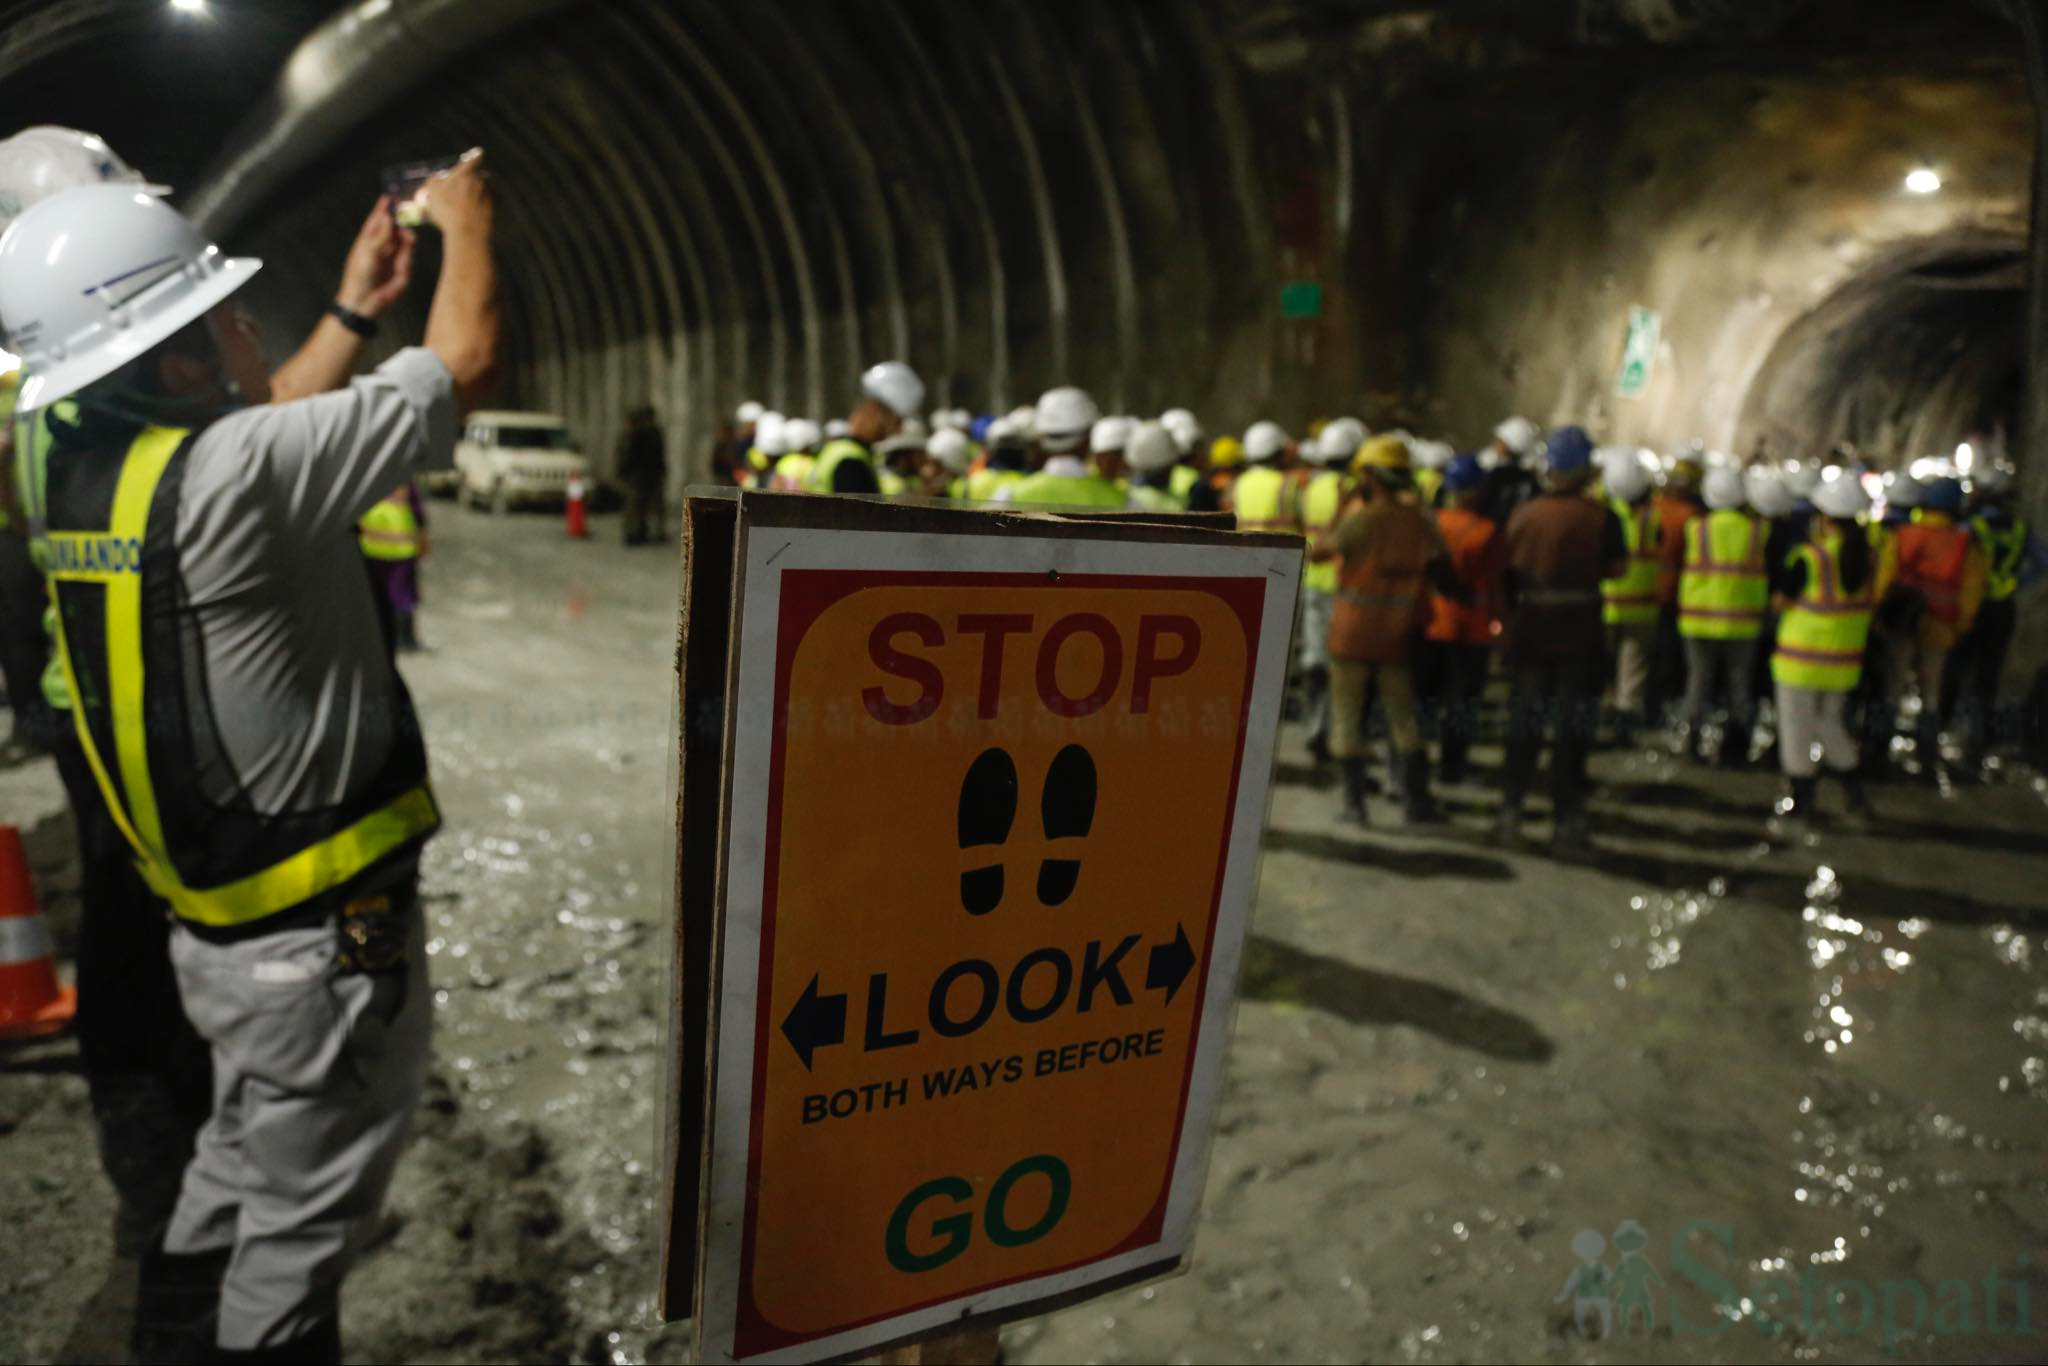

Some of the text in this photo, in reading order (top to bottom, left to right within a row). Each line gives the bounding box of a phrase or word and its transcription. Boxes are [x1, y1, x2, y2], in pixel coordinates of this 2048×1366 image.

[861, 611, 1201, 726] STOP
[863, 933, 1143, 1052] LOOK
[802, 1029, 1165, 1124] BOTH WAYS BEFORE
[885, 1154, 1072, 1273] GO
